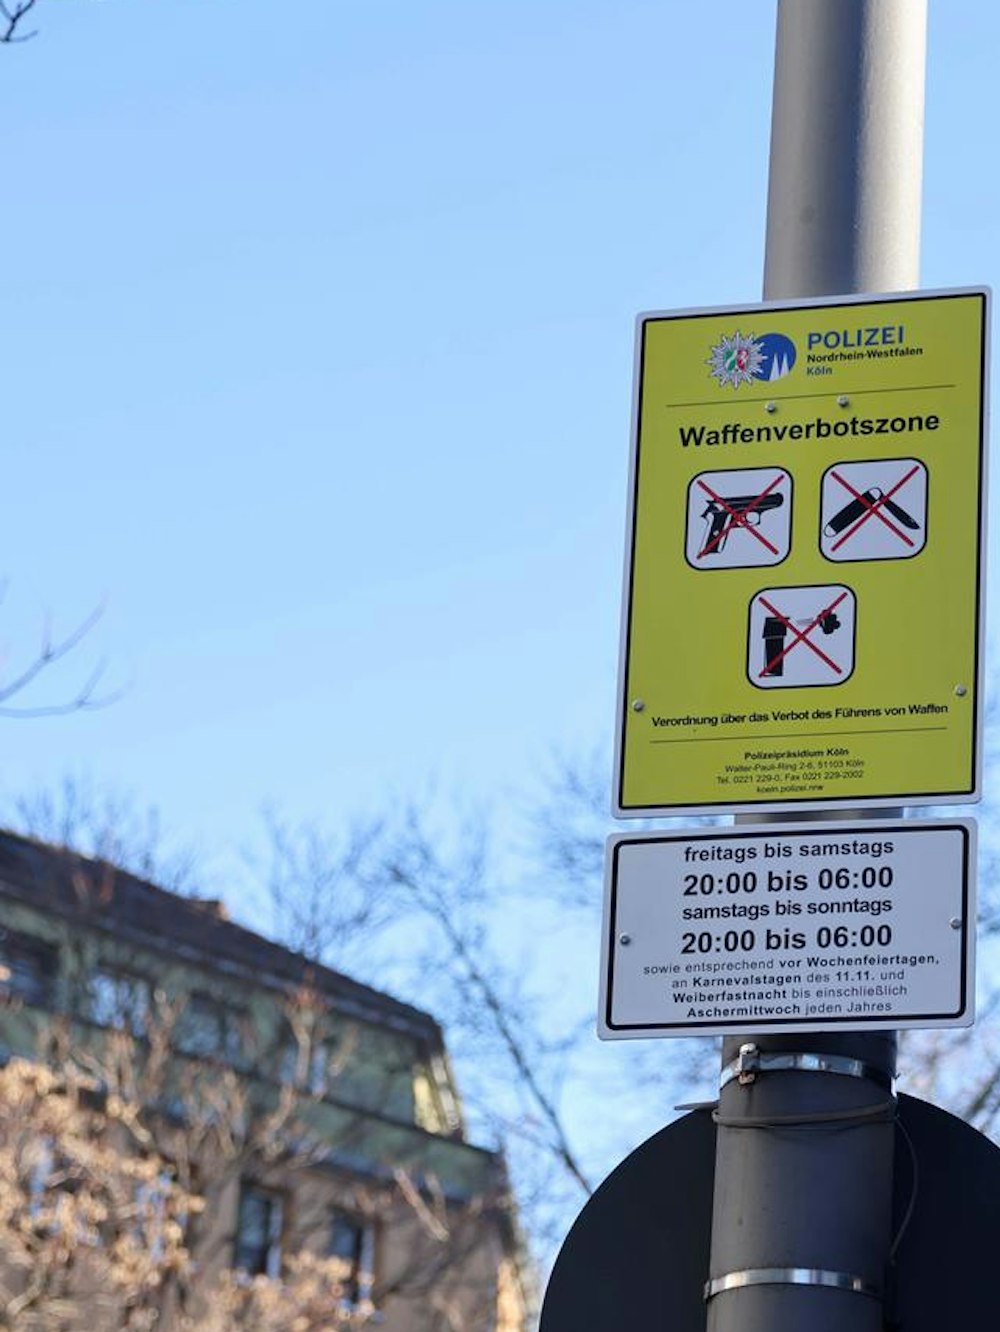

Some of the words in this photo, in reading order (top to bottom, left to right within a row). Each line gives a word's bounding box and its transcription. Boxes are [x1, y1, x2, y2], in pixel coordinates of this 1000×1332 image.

[807, 325, 905, 350] POLIZEI
[807, 347, 924, 363] Nordrhein-Westfalen
[806, 366, 833, 376] Köln
[679, 414, 940, 447] Waffenverbotszone
[652, 715, 718, 728] Verordnung
[721, 712, 747, 724] über
[749, 712, 769, 722] das
[772, 710, 809, 721] Verbot
[812, 708, 833, 719] des
[835, 707, 882, 718] Führens
[885, 706, 906, 716] von
[908, 703, 949, 714] Waffen
[744, 749, 824, 762] Polizeipräsidium
[826, 747, 849, 757] Köln
[846, 758, 865, 767] Köln
[733, 775, 753, 783] 0221
[785, 773, 800, 781] Fax
[802, 771, 822, 780] 0221
[684, 845, 758, 864] freitags
[763, 842, 793, 859] bis
[799, 839, 894, 859] samstags
[682, 871, 758, 897] 20:00
[767, 870, 808, 892] bis
[817, 866, 894, 890] 06:00
[682, 902, 770, 921] samstags
[775, 900, 802, 916] bis
[807, 898, 893, 915] sonntags
[681, 930, 756, 955] 20:00
[765, 928, 806, 951] bis
[815, 924, 893, 949] 06:00
[643, 963, 681, 975] sowie
[685, 958, 775, 974] entsprechend
[778, 958, 802, 968] vor
[806, 953, 940, 968] Wochenfeiertagen,
[671, 979, 688, 988] an
[692, 973, 801, 987] Karnevalstagen
[806, 972, 830, 983] des
[836, 970, 875, 982] 11.11.
[880, 969, 905, 981] und
[673, 989, 787, 1004] Weiberfastnacht
[791, 987, 811, 999] bis
[816, 984, 908, 998] einschließlich
[686, 1004, 800, 1018] Aschermittwoch
[805, 1002, 842, 1016] jeden
[847, 1001, 893, 1013] Jahres
